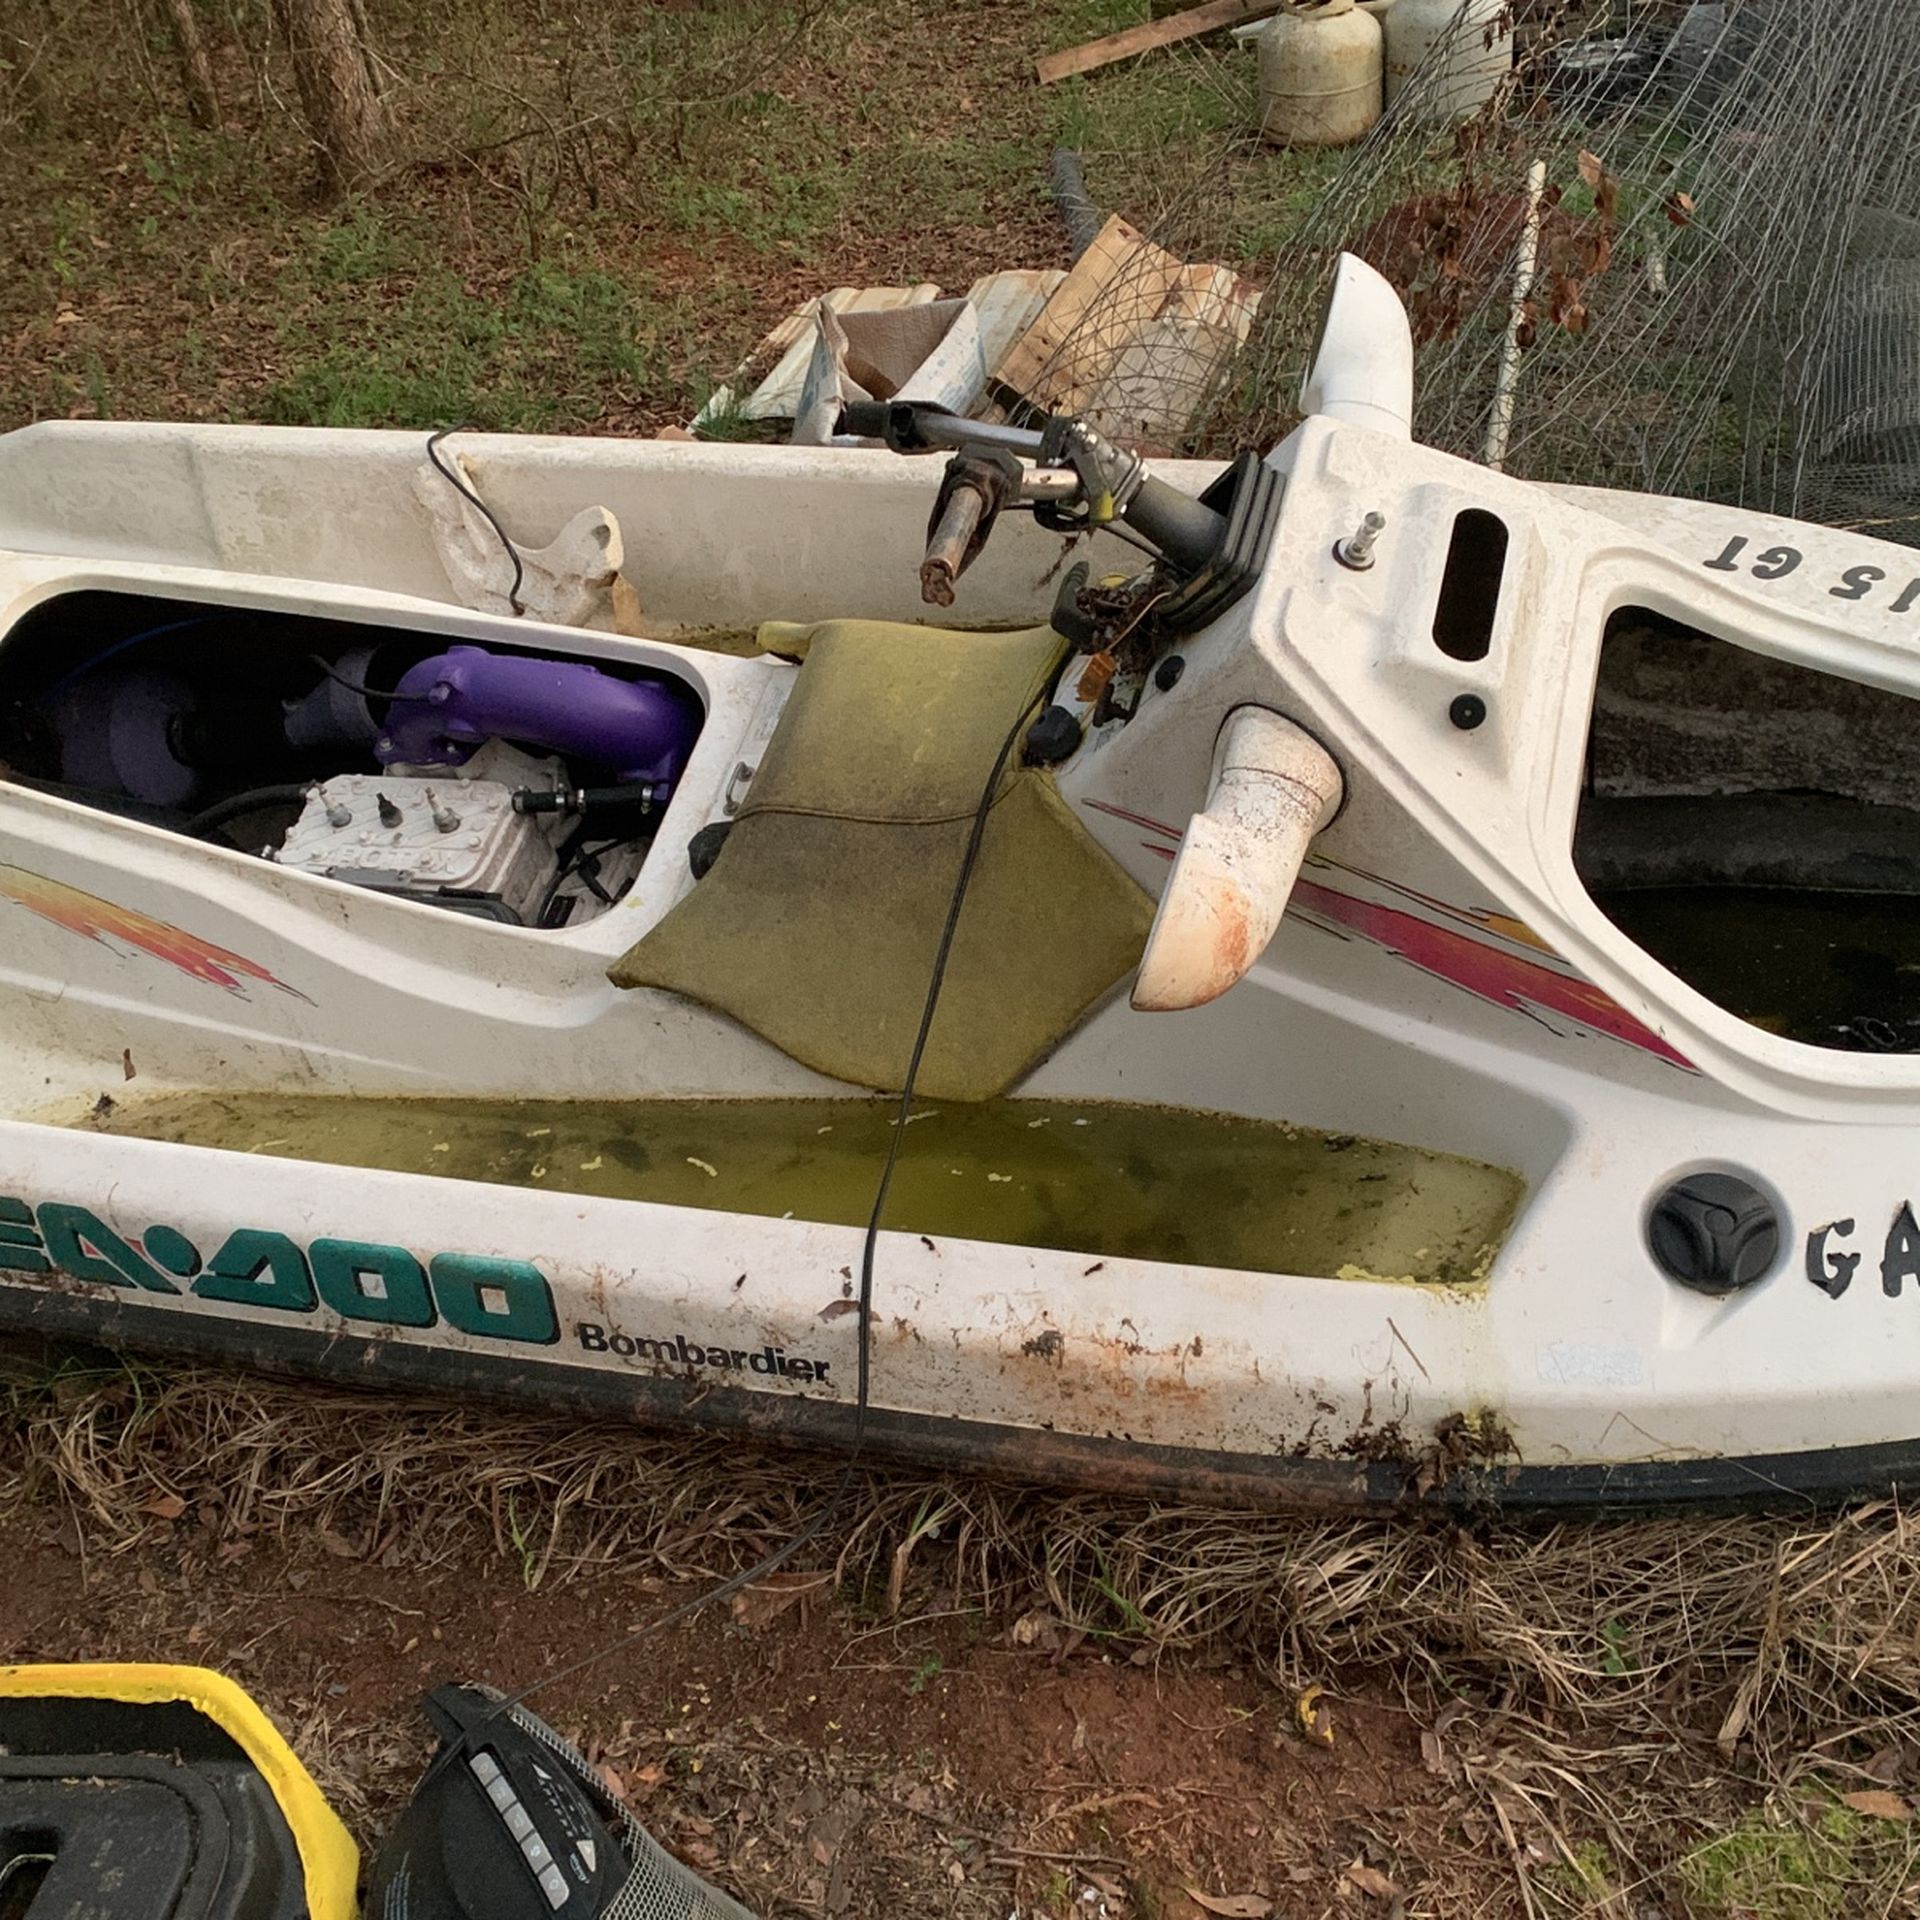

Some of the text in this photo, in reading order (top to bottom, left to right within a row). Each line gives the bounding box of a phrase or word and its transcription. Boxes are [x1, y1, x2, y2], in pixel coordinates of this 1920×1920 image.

[1703, 535, 1803, 579] GT
[1806, 1199, 1920, 1300] GA
[578, 1322, 831, 1384] Bombardier
